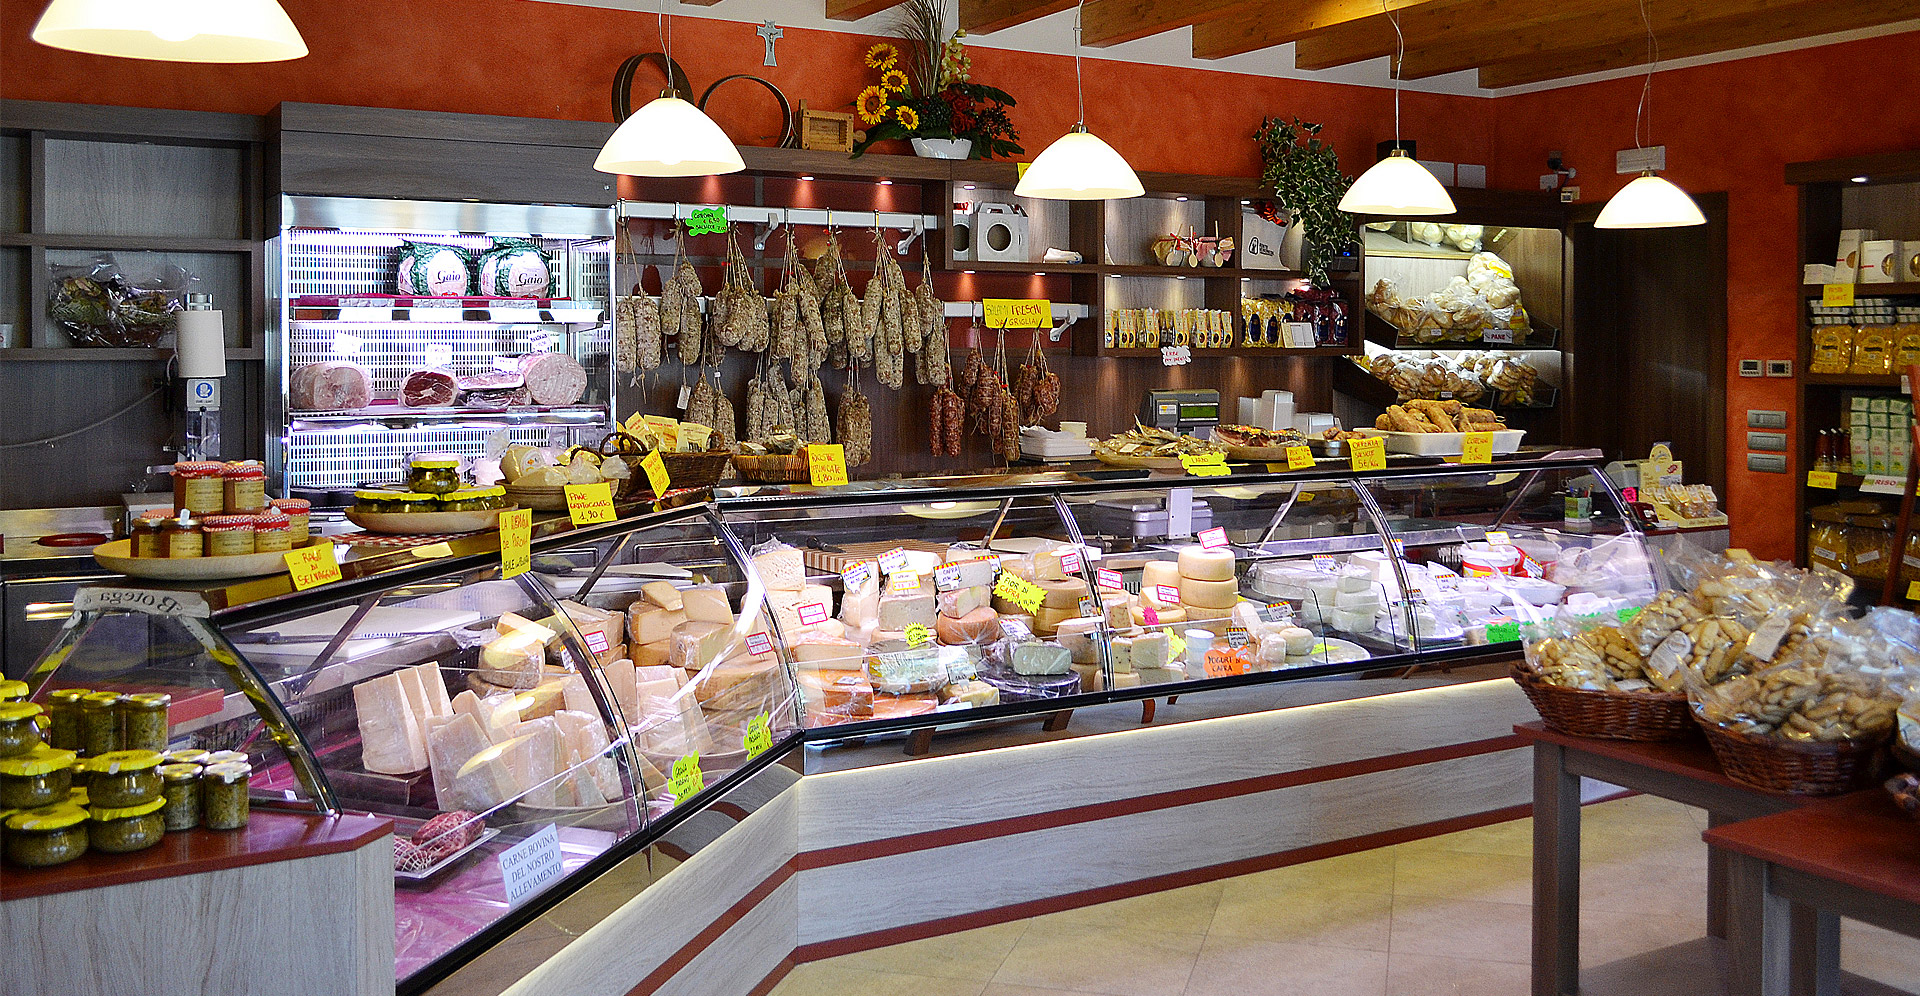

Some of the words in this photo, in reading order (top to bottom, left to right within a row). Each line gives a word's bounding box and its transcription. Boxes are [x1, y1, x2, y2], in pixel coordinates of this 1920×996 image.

[435, 270, 461, 284] Gaio
[515, 273, 543, 287] Gaio
[1011, 304, 1042, 316] FRESCHI
[1874, 479, 1897, 487] RISO
[569, 492, 588, 501] PANE
[579, 510, 598, 522] 1,90
[1208, 656, 1232, 664] YOGURT
[502, 847, 528, 870] CARNE
[528, 833, 555, 856] BOVINA
[512, 867, 526, 883] DEL
[526, 849, 555, 874] NOSTRO
[511, 862, 562, 902] ALLEVAMENTO
